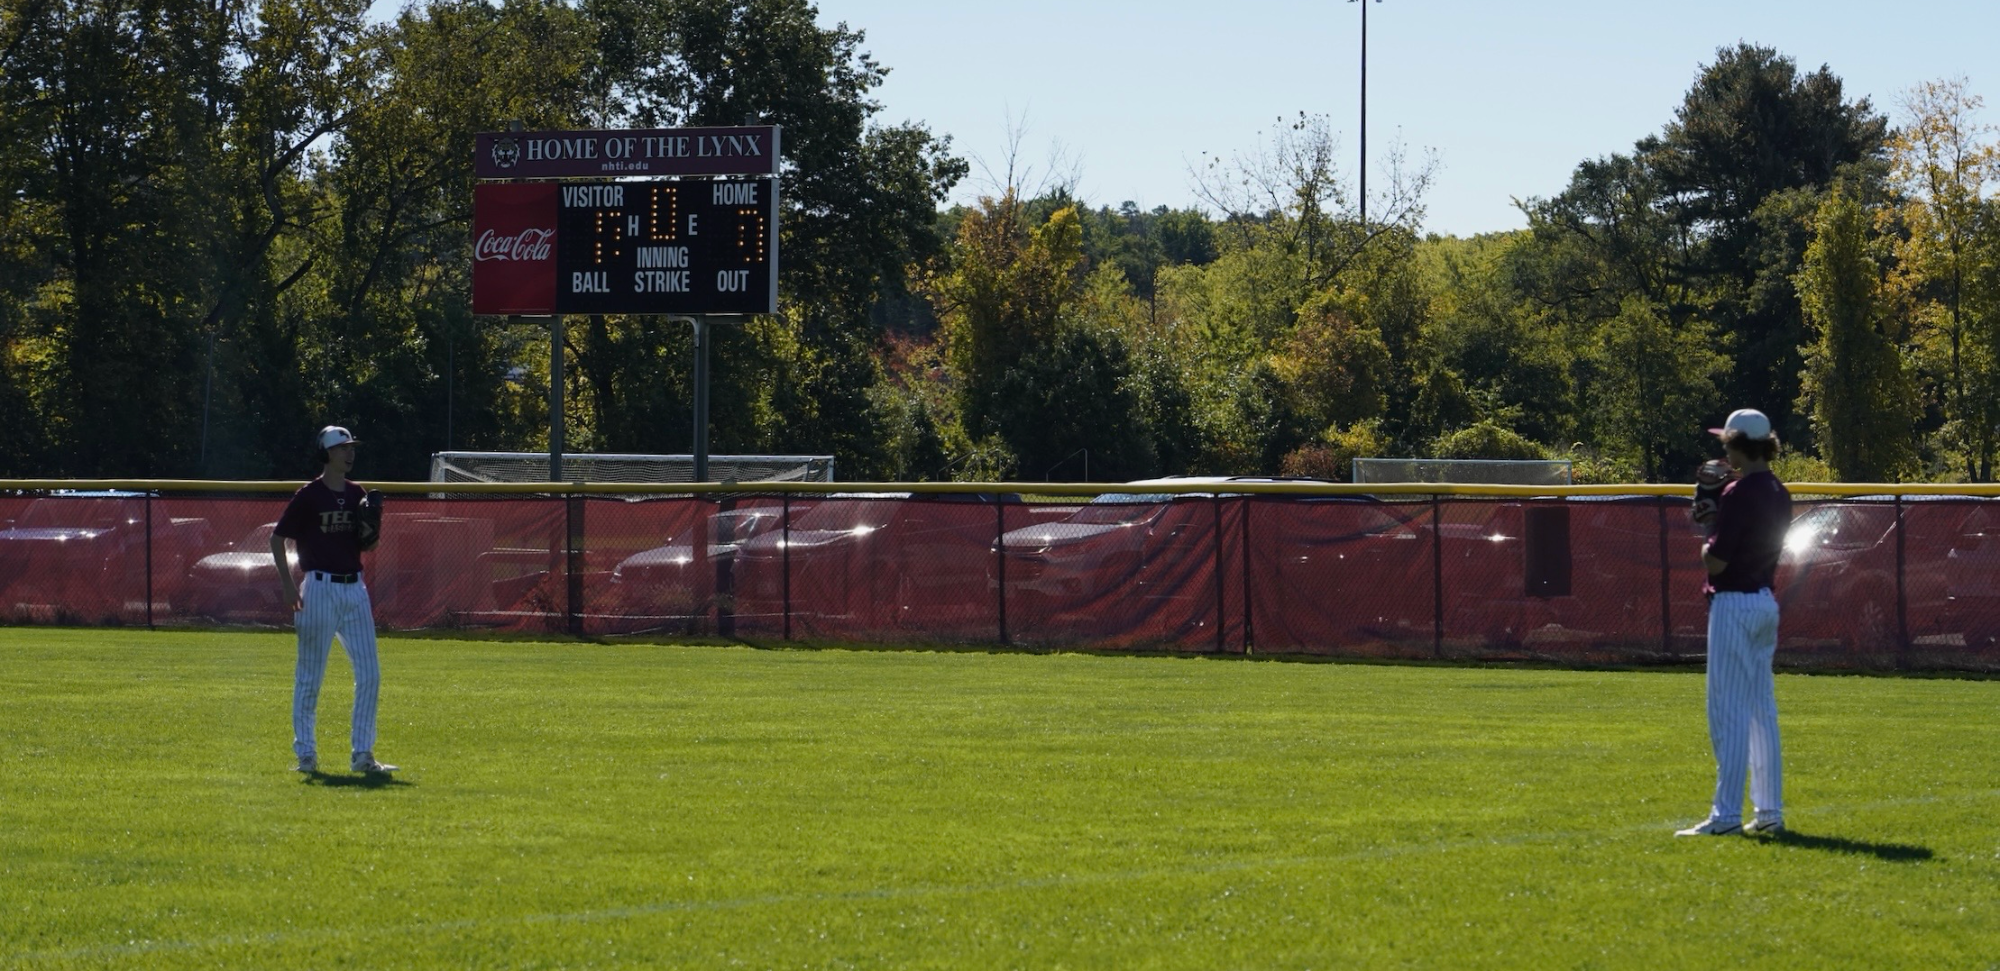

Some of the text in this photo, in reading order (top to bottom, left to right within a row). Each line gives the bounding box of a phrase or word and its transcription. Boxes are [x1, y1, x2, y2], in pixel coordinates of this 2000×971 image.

[526, 134, 762, 161] HOME OF THE LYNX
[601, 161, 649, 171] nhti.edu
[562, 185, 624, 208] VISITOR
[713, 183, 758, 205] HOME
[628, 215, 639, 237] H
[688, 214, 698, 236] E
[475, 228, 556, 262] Coca-Cola
[637, 246, 689, 268] INNING
[572, 271, 610, 293] BALL
[634, 270, 690, 293] STRIKE
[717, 270, 749, 292] OUT
